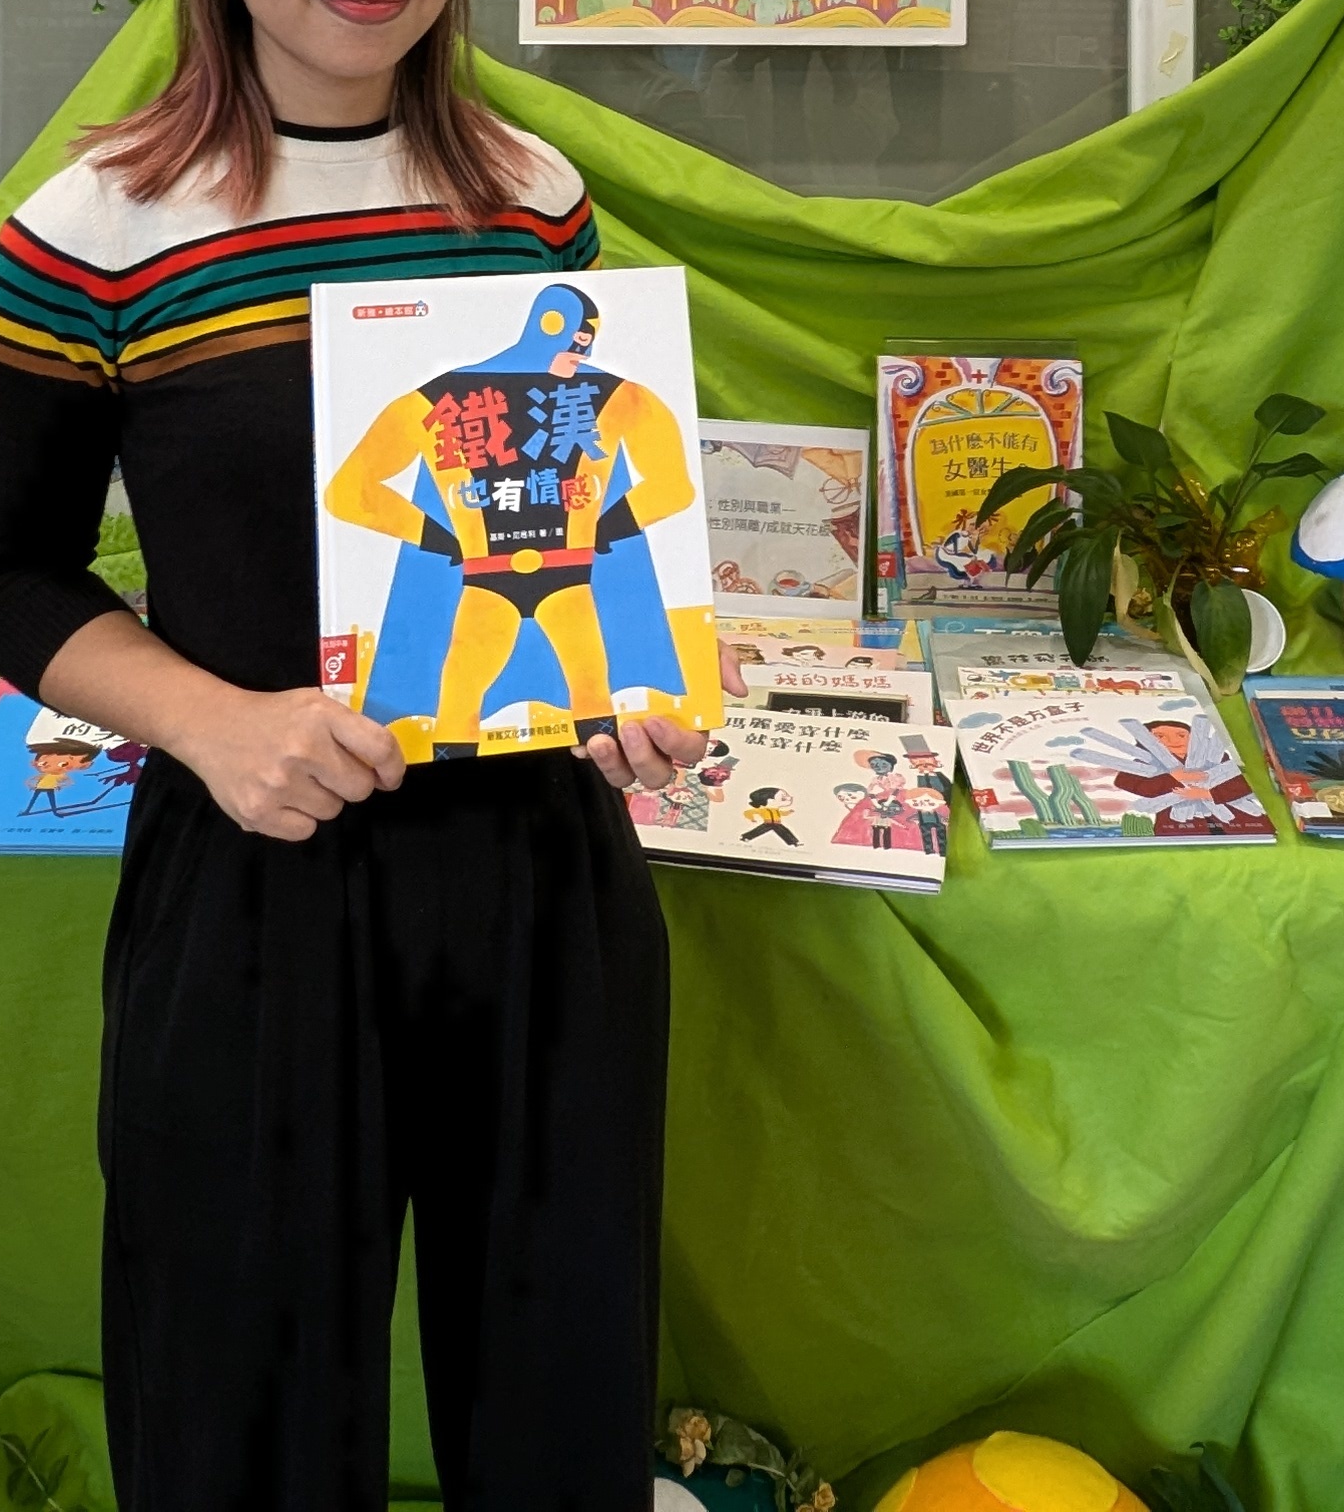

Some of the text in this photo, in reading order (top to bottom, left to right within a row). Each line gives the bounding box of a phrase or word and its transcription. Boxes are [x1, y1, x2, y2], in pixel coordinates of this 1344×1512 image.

[422, 382, 609, 470] 鐵漢
[929, 432, 1039, 455] 為什麼不能有
[774, 673, 891, 689] 我的媽媽
[971, 701, 1085, 755] 世界不是方盒子
